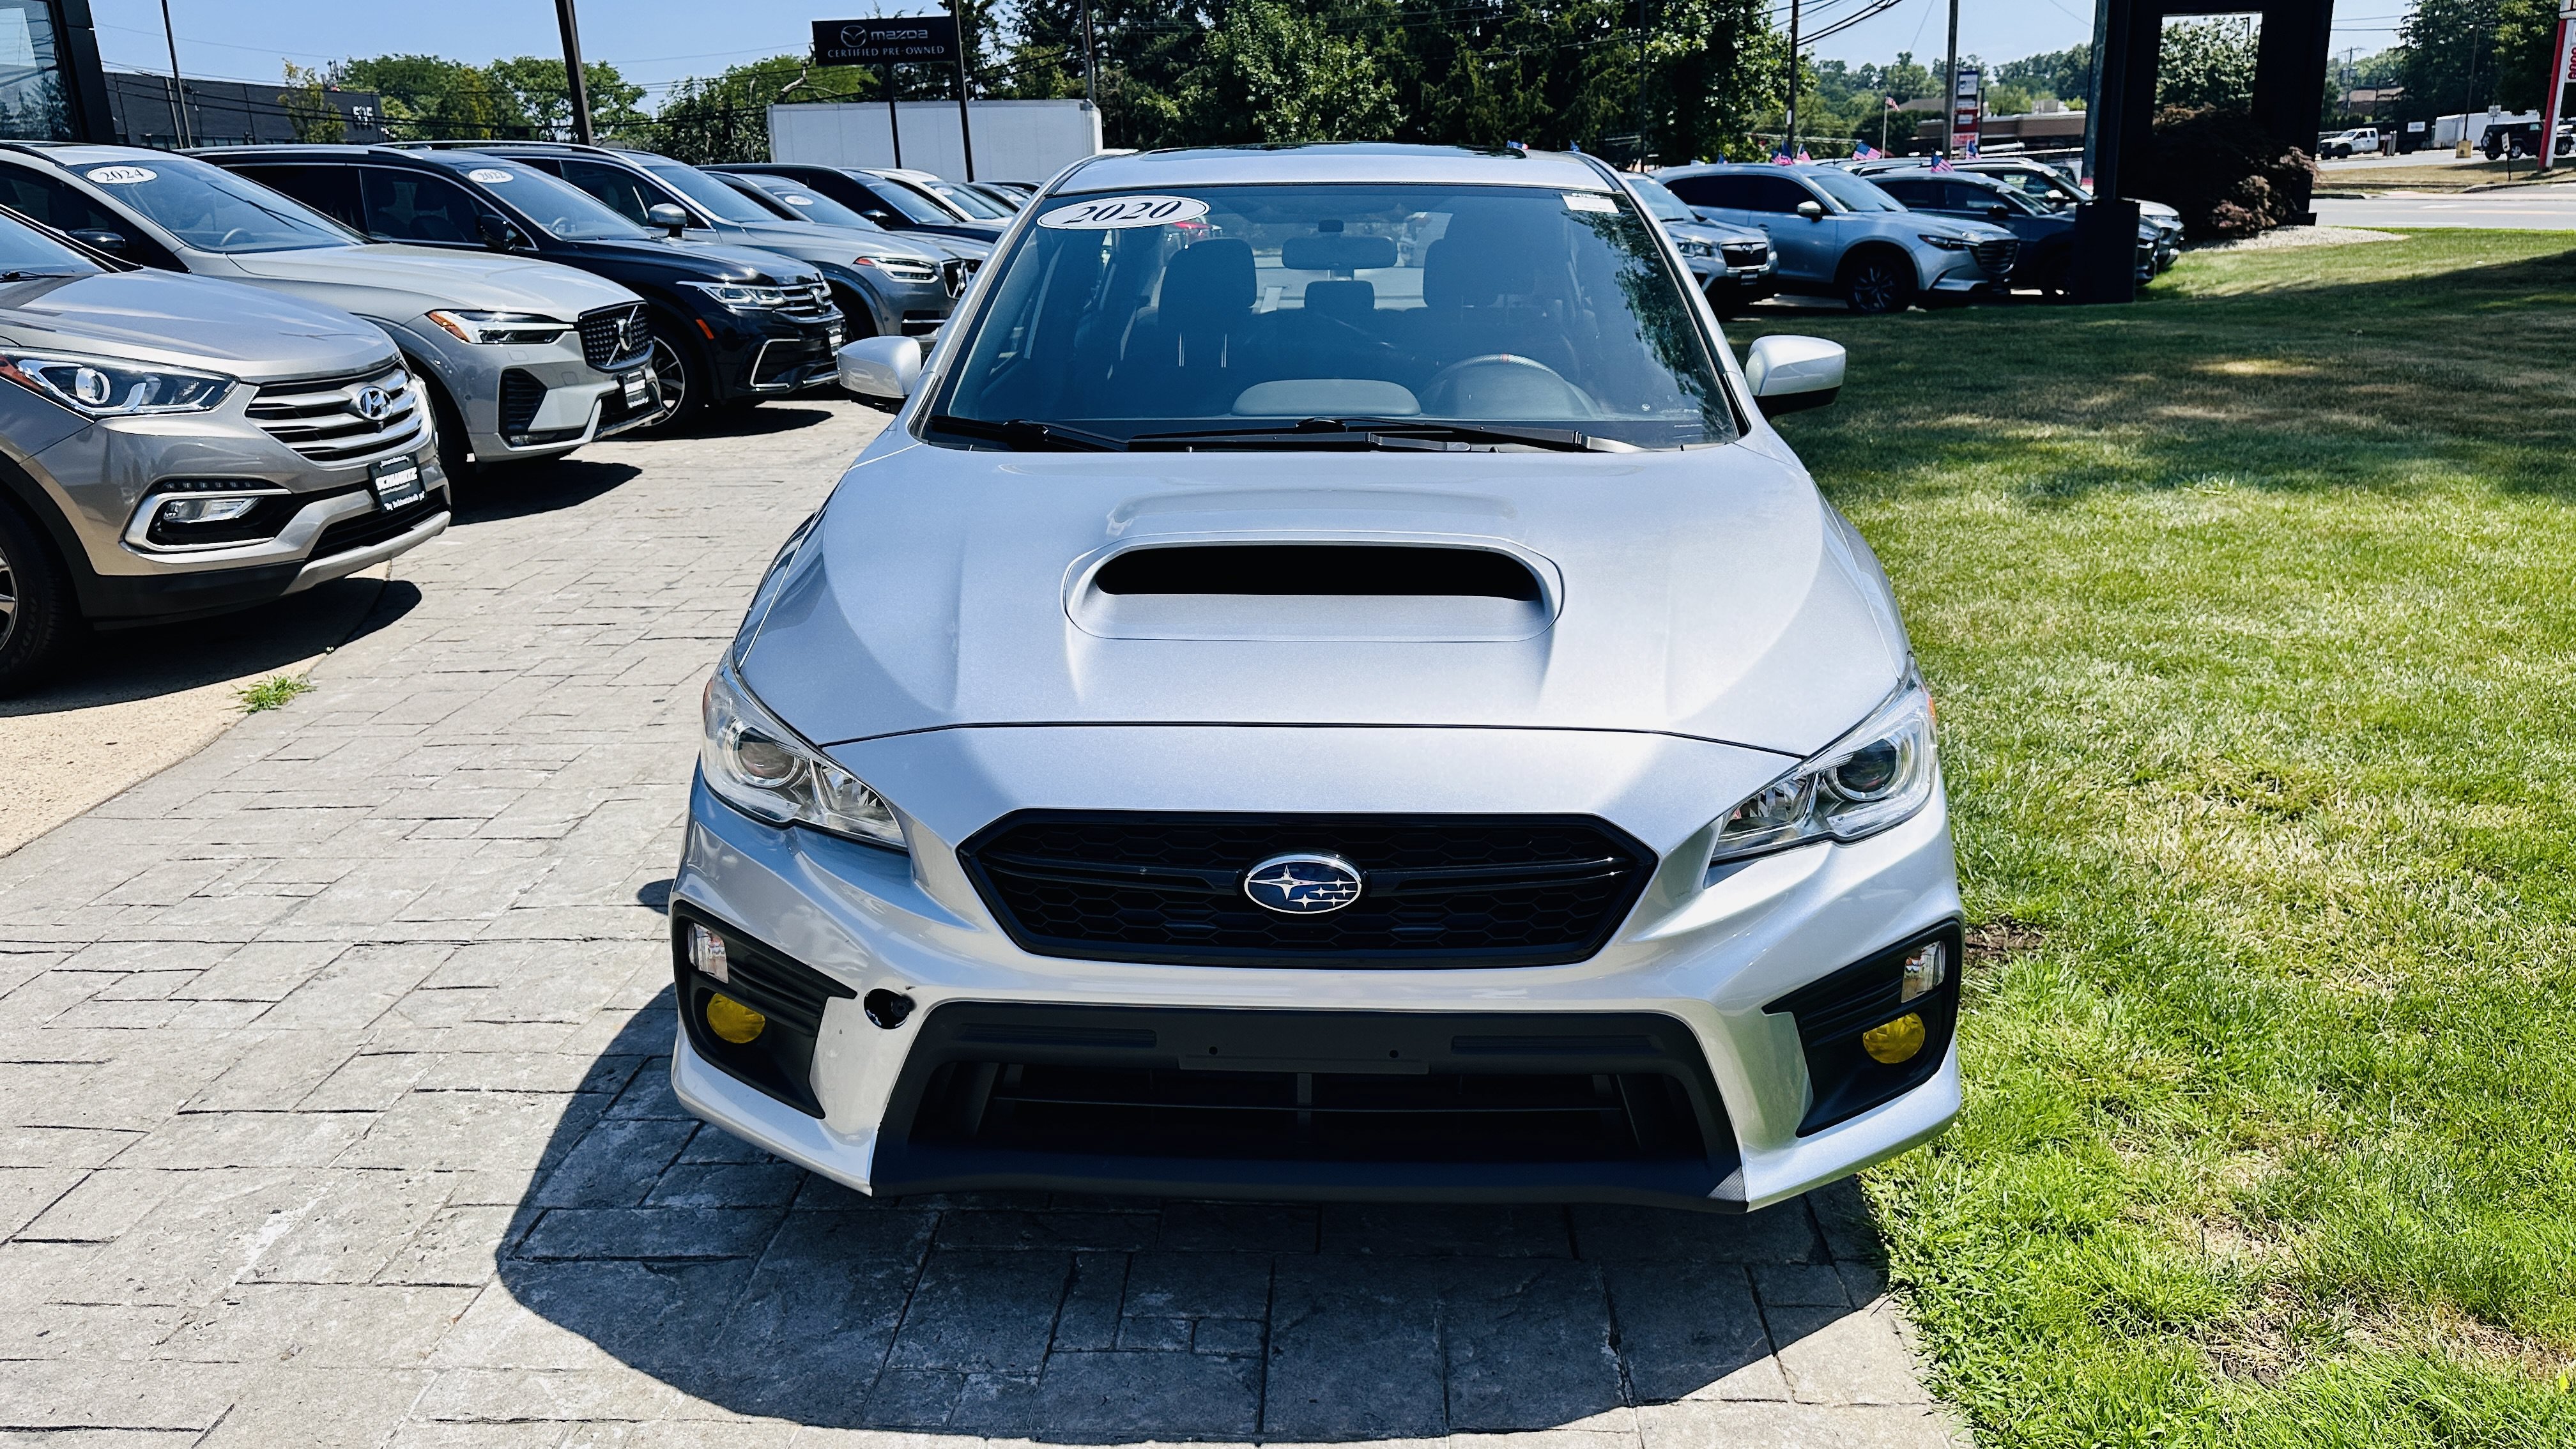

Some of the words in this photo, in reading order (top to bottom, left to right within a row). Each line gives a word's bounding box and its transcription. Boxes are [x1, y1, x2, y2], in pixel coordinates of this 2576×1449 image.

[827, 48, 878, 57] CERTIFIED
[883, 46, 944, 56] PRE-OWNED
[99, 169, 144, 181] 2024
[1061, 201, 1182, 224] 2020
